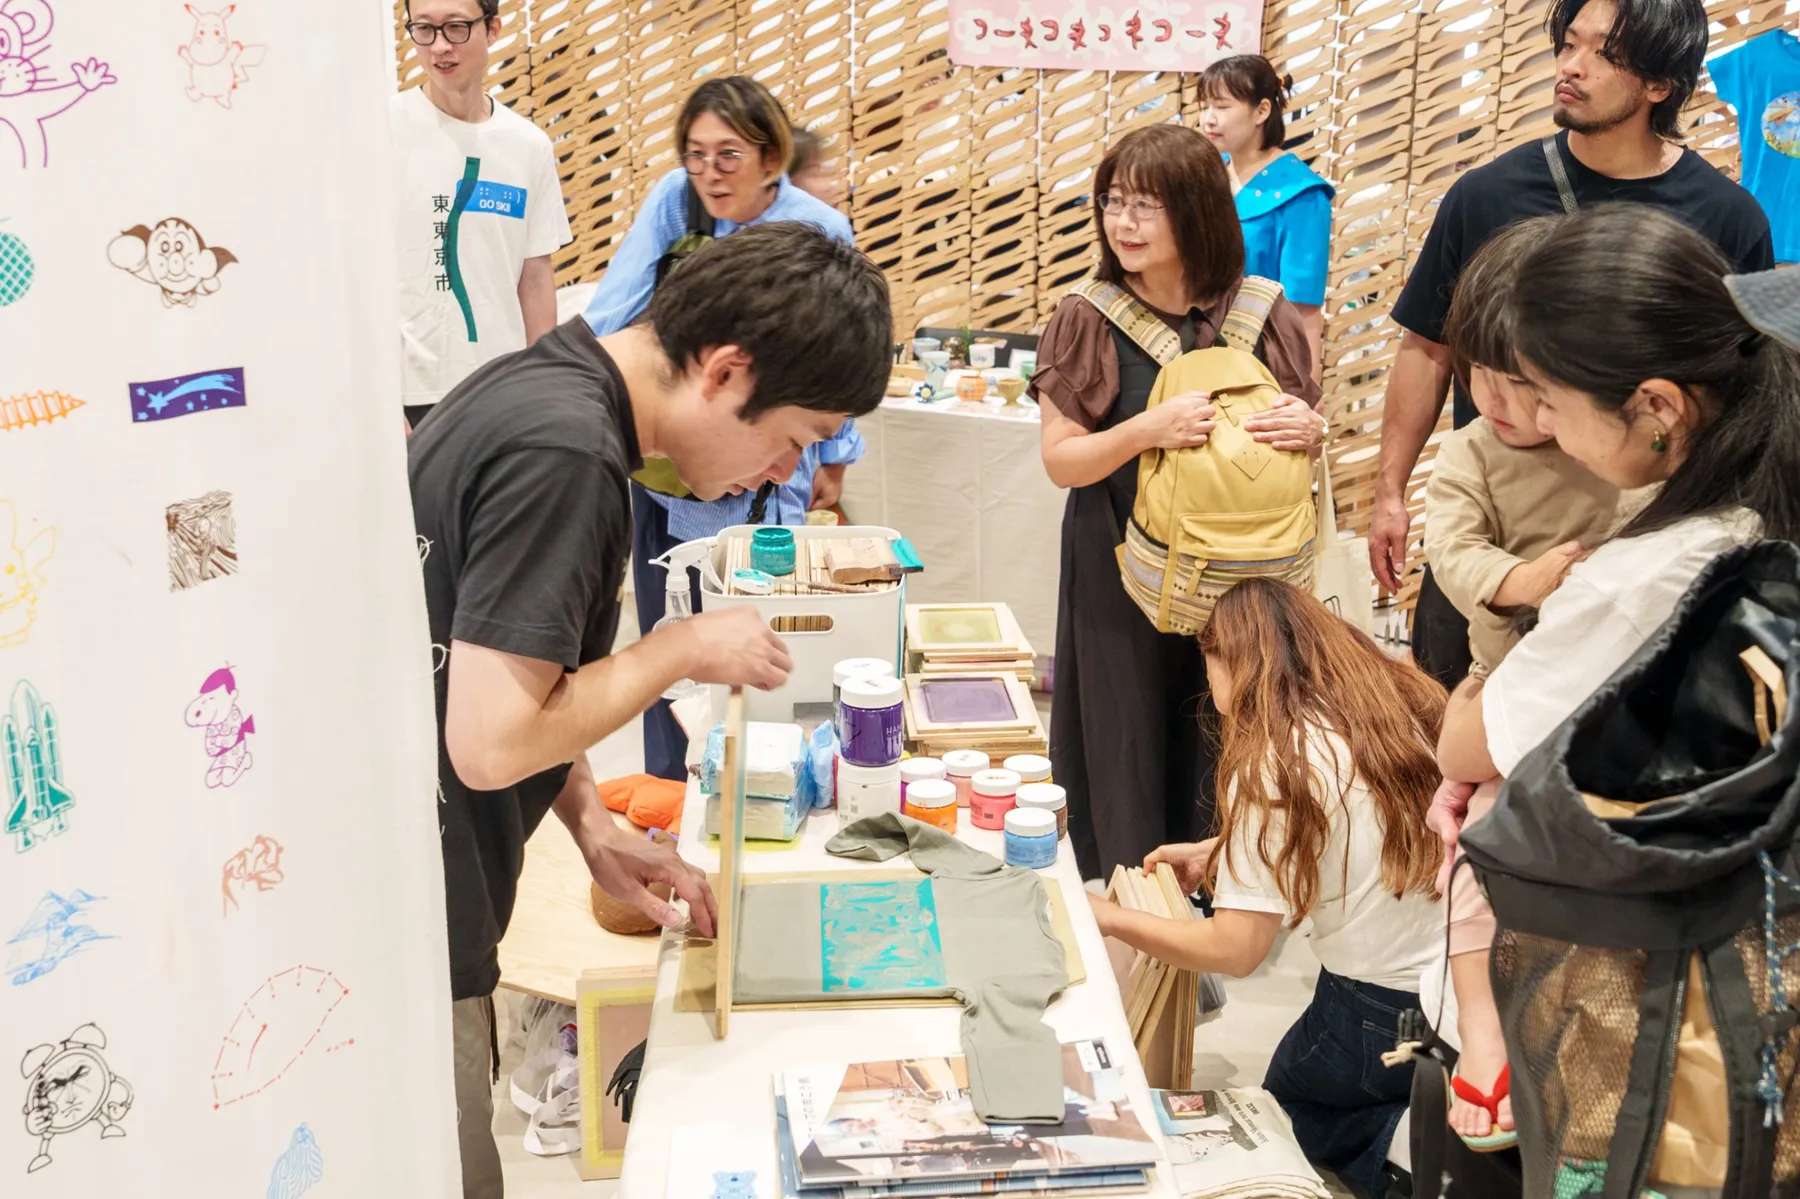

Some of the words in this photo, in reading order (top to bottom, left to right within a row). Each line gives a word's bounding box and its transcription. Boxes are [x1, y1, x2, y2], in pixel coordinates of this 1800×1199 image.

[479, 199, 495, 209] GO
[432, 194, 453, 292] 東東京市
